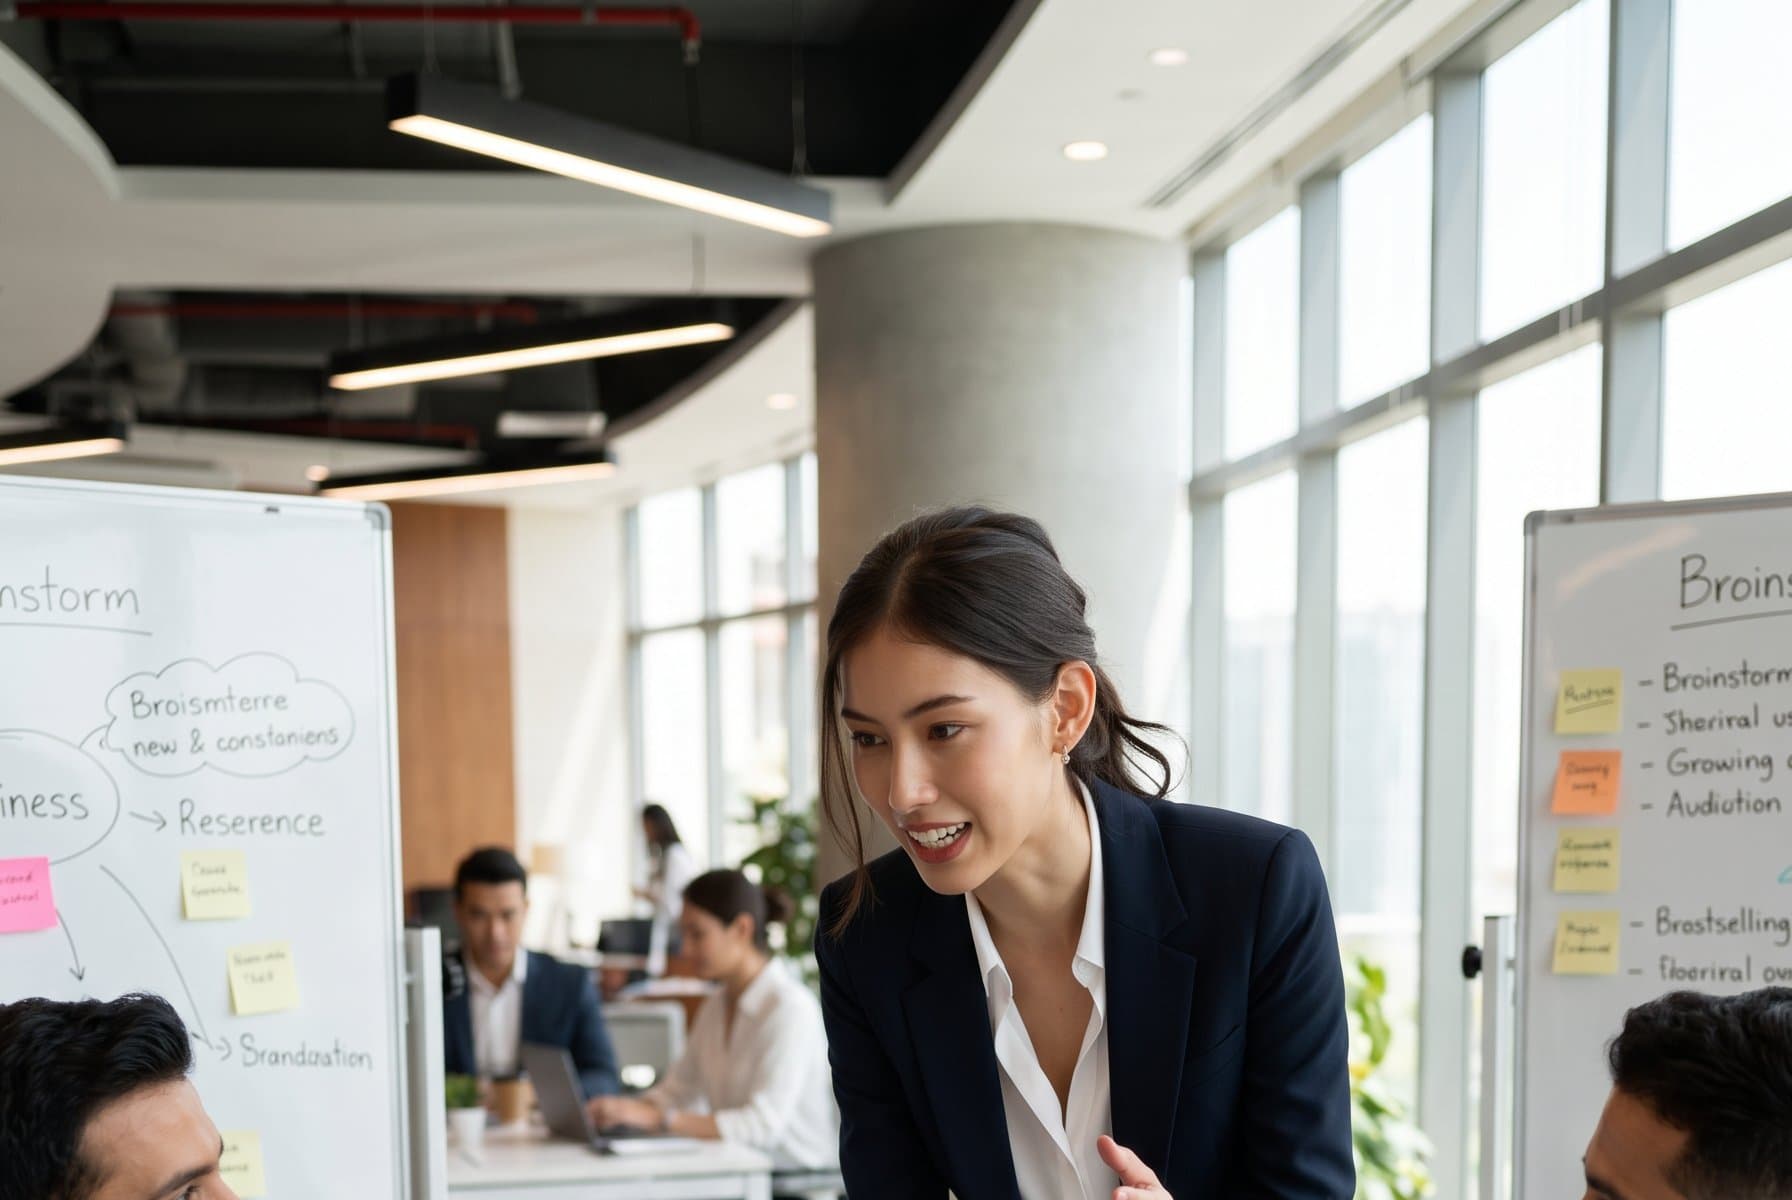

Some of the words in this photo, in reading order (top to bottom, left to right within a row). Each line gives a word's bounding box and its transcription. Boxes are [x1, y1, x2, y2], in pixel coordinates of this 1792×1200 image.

[133, 739, 177, 757] new
[190, 728, 204, 753] &
[1666, 747, 1773, 783] Growing
[179, 798, 326, 836] Reserence
